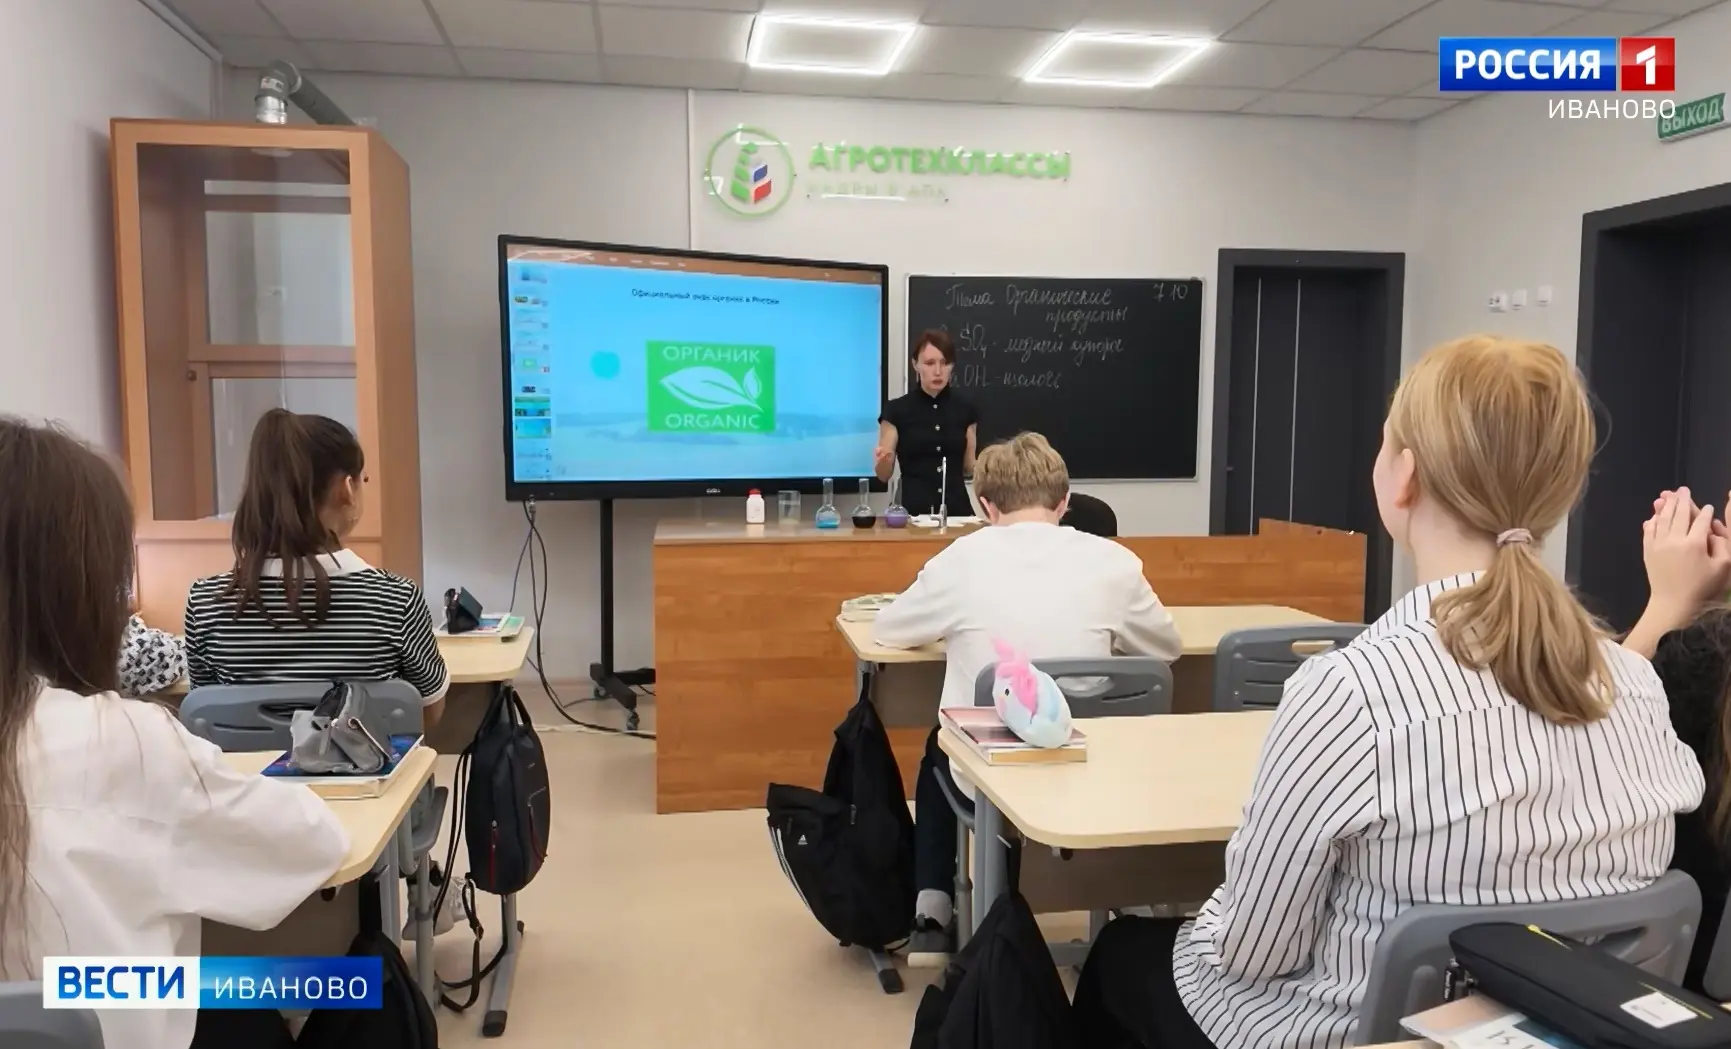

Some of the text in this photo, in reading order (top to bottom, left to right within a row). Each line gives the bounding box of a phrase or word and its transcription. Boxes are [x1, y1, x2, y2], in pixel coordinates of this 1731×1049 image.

[1661, 98, 1721, 134] ВЫХОД
[808, 142, 1071, 179] АГРОТЕХКЛАССЫ
[662, 345, 760, 363] ОРГАНИК
[664, 412, 760, 430] ORGANIC
